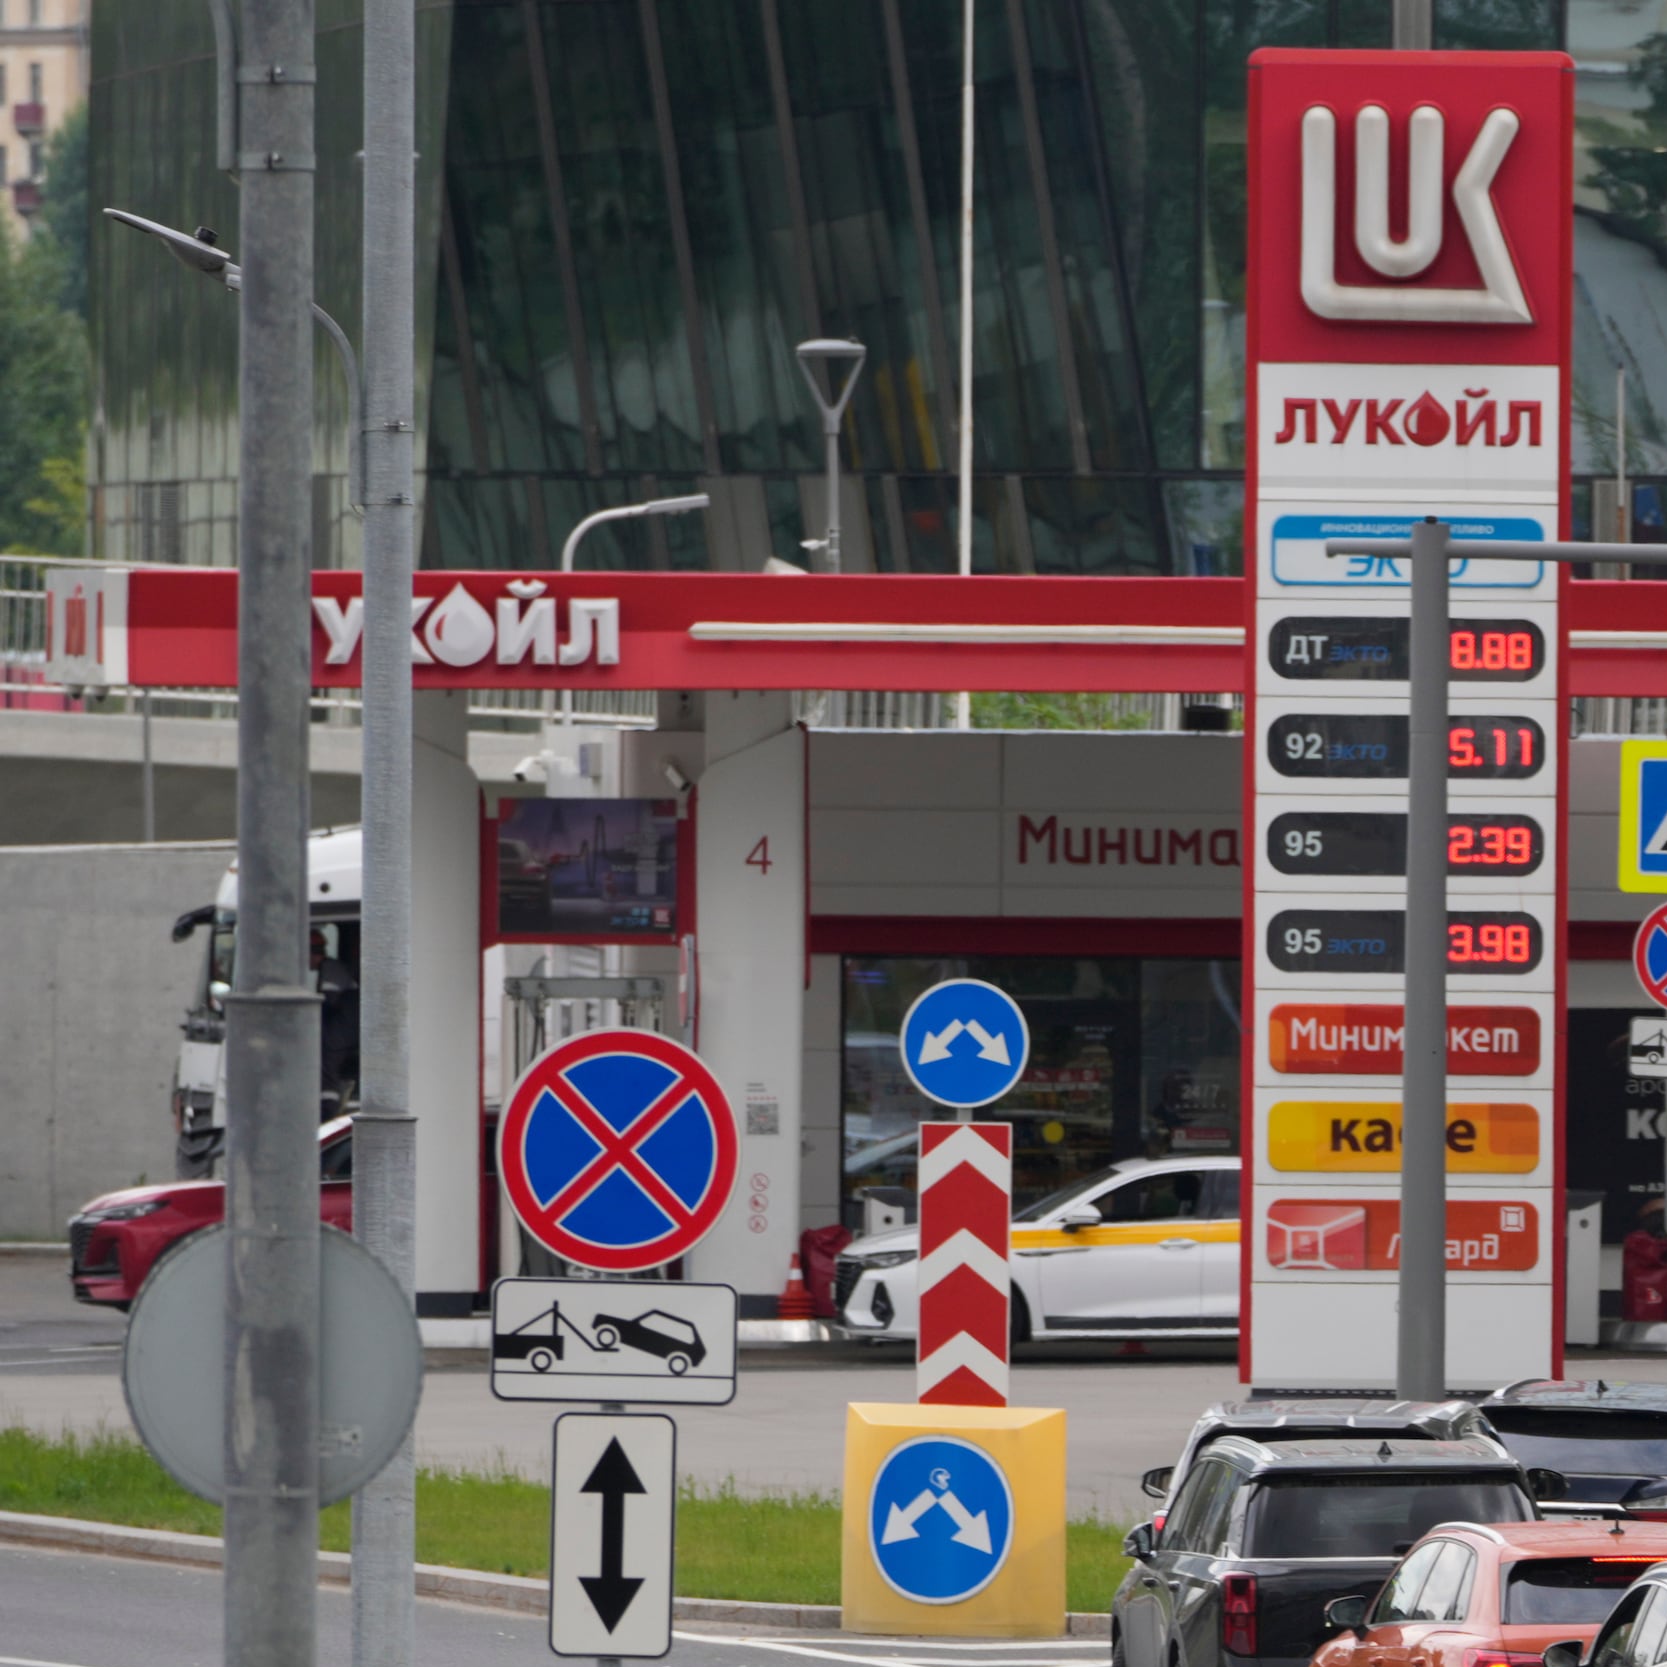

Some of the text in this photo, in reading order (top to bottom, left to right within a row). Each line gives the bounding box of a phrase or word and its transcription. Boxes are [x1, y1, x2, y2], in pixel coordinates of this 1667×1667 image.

[1285, 635, 1391, 665] ДТ ЭКТО
[1450, 632, 1533, 669] 8.88
[1285, 733, 1389, 761] 92 ЭКТО
[1449, 728, 1533, 767] 5.11
[745, 835, 773, 876] 4
[1018, 814, 1241, 867] Минима
[1284, 830, 1323, 857] 95
[1448, 826, 1532, 864] 2.39
[1284, 928, 1386, 955] 95 ЭКТО
[1447, 924, 1530, 962] 3.98
[1290, 1017, 1520, 1053] Минимкет
[1331, 1117, 1477, 1153] кае
